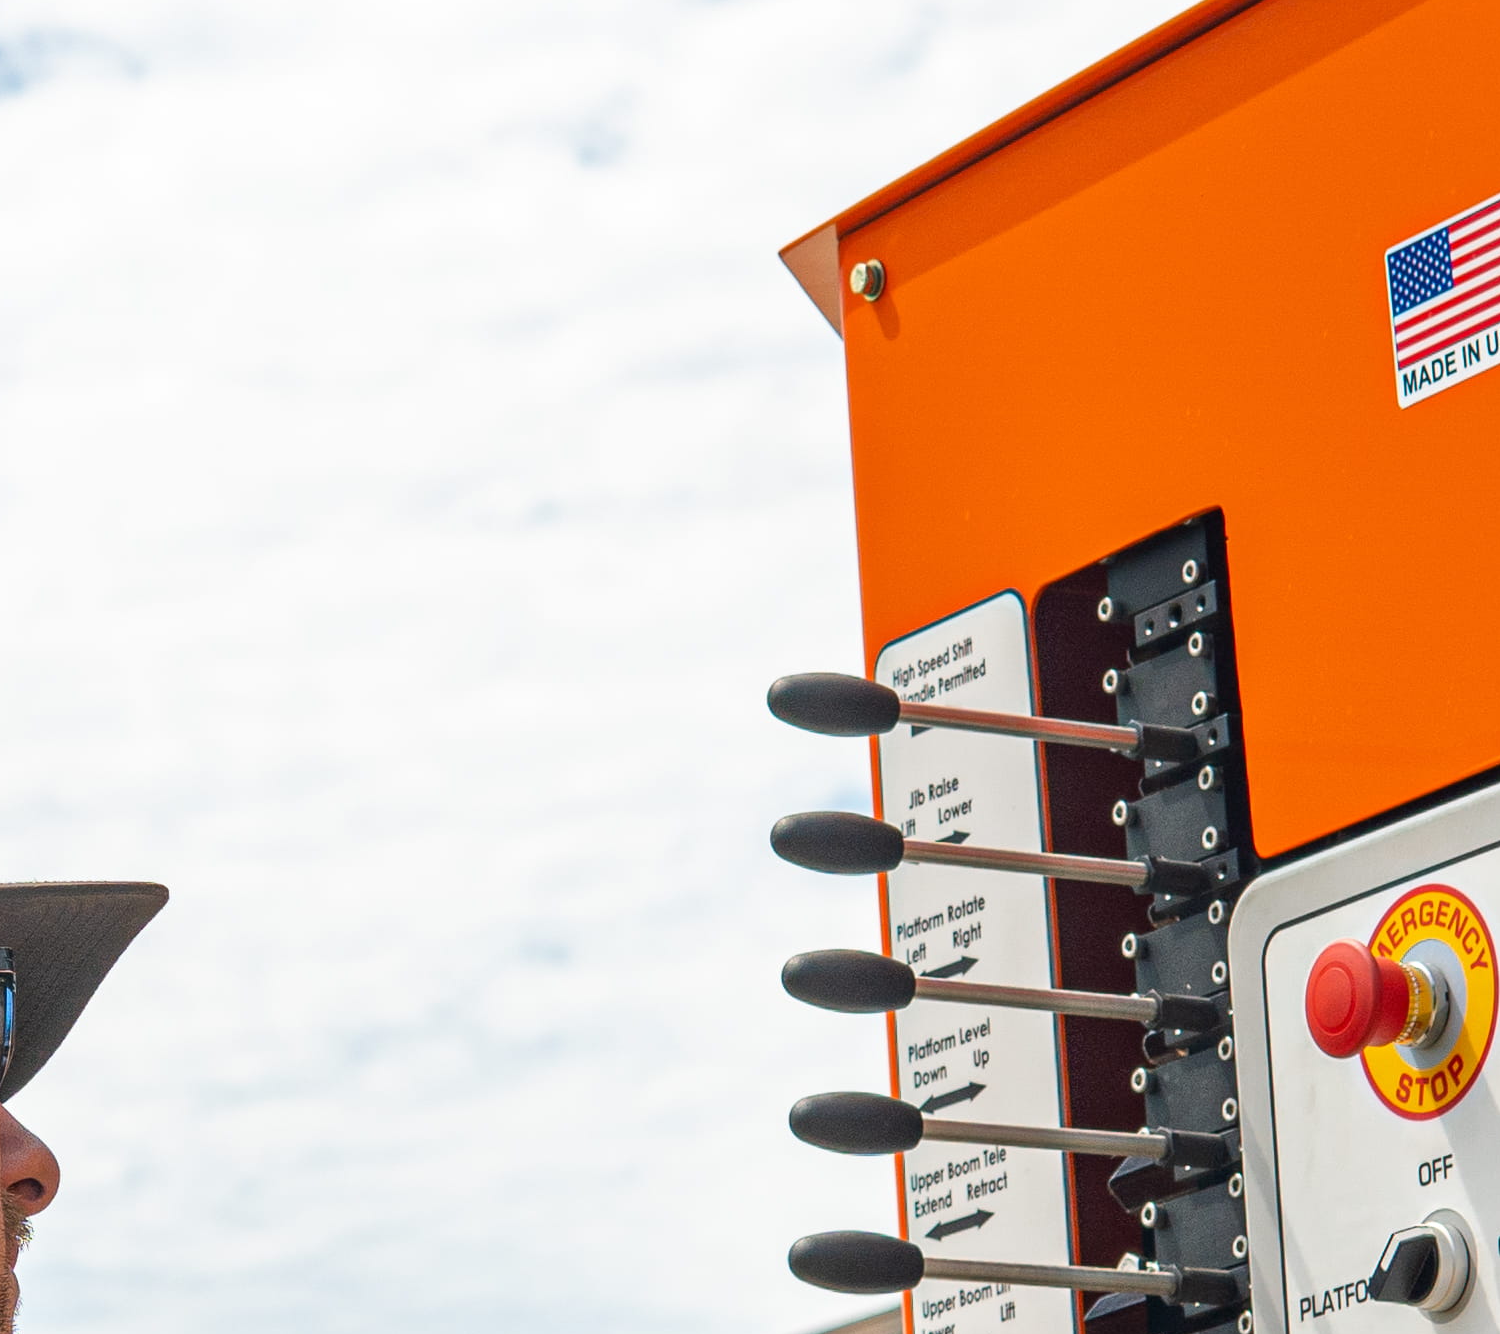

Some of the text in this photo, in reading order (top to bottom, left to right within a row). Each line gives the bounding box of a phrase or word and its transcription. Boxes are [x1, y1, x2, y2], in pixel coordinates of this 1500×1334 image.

[1402, 350, 1457, 397] MADE
[1462, 339, 1481, 368] IN
[892, 636, 974, 687] High Speed Shift
[938, 658, 987, 695] Permitted
[908, 775, 959, 810] Jib Raise
[900, 798, 973, 839] Lift Lower
[896, 894, 986, 943] Platform Rotate
[1376, 900, 1489, 971] MERGENCY
[905, 920, 982, 966] Left Right
[908, 1016, 991, 1063] Platform Level
[913, 1049, 990, 1089] Down Up
[1395, 1054, 1465, 1106] STOP
[910, 1146, 1007, 1193] Upper Boom Tele
[1417, 1154, 1454, 1187] OFF
[914, 1173, 1009, 1219] Extend Retract
[922, 1296, 956, 1320] Upper
[959, 1285, 993, 1307] Boom
[1000, 1300, 1016, 1323] Lift
[1299, 1278, 1369, 1323] PLATFO
